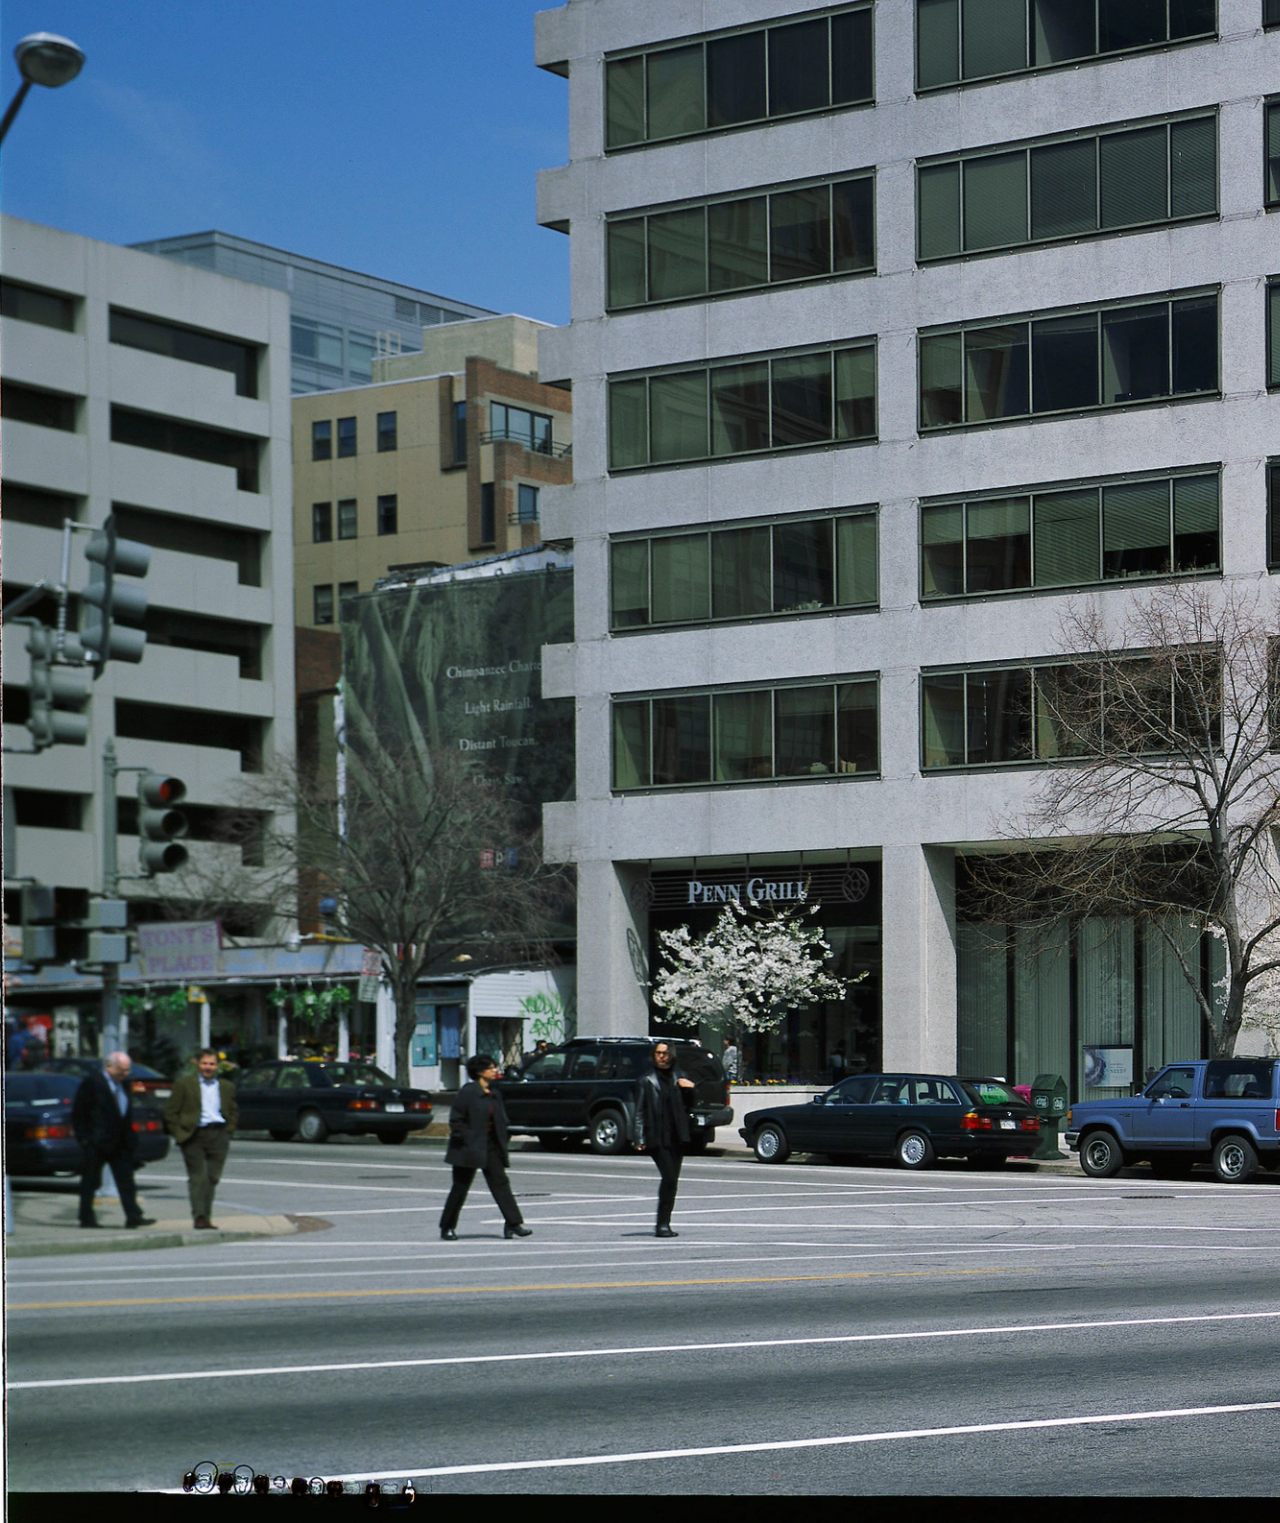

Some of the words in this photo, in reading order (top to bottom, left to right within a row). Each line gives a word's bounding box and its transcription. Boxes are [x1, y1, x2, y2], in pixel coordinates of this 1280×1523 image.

[446, 665, 506, 681] Chimpanzee
[509, 659, 541, 674] Chatte
[465, 699, 491, 717] Light
[459, 738, 496, 751] Distant
[499, 735, 539, 748] Toucan.
[687, 881, 742, 904] PENN
[747, 877, 806, 902] GRILL
[142, 926, 214, 947] TONY'S
[147, 954, 214, 973] PLACE
